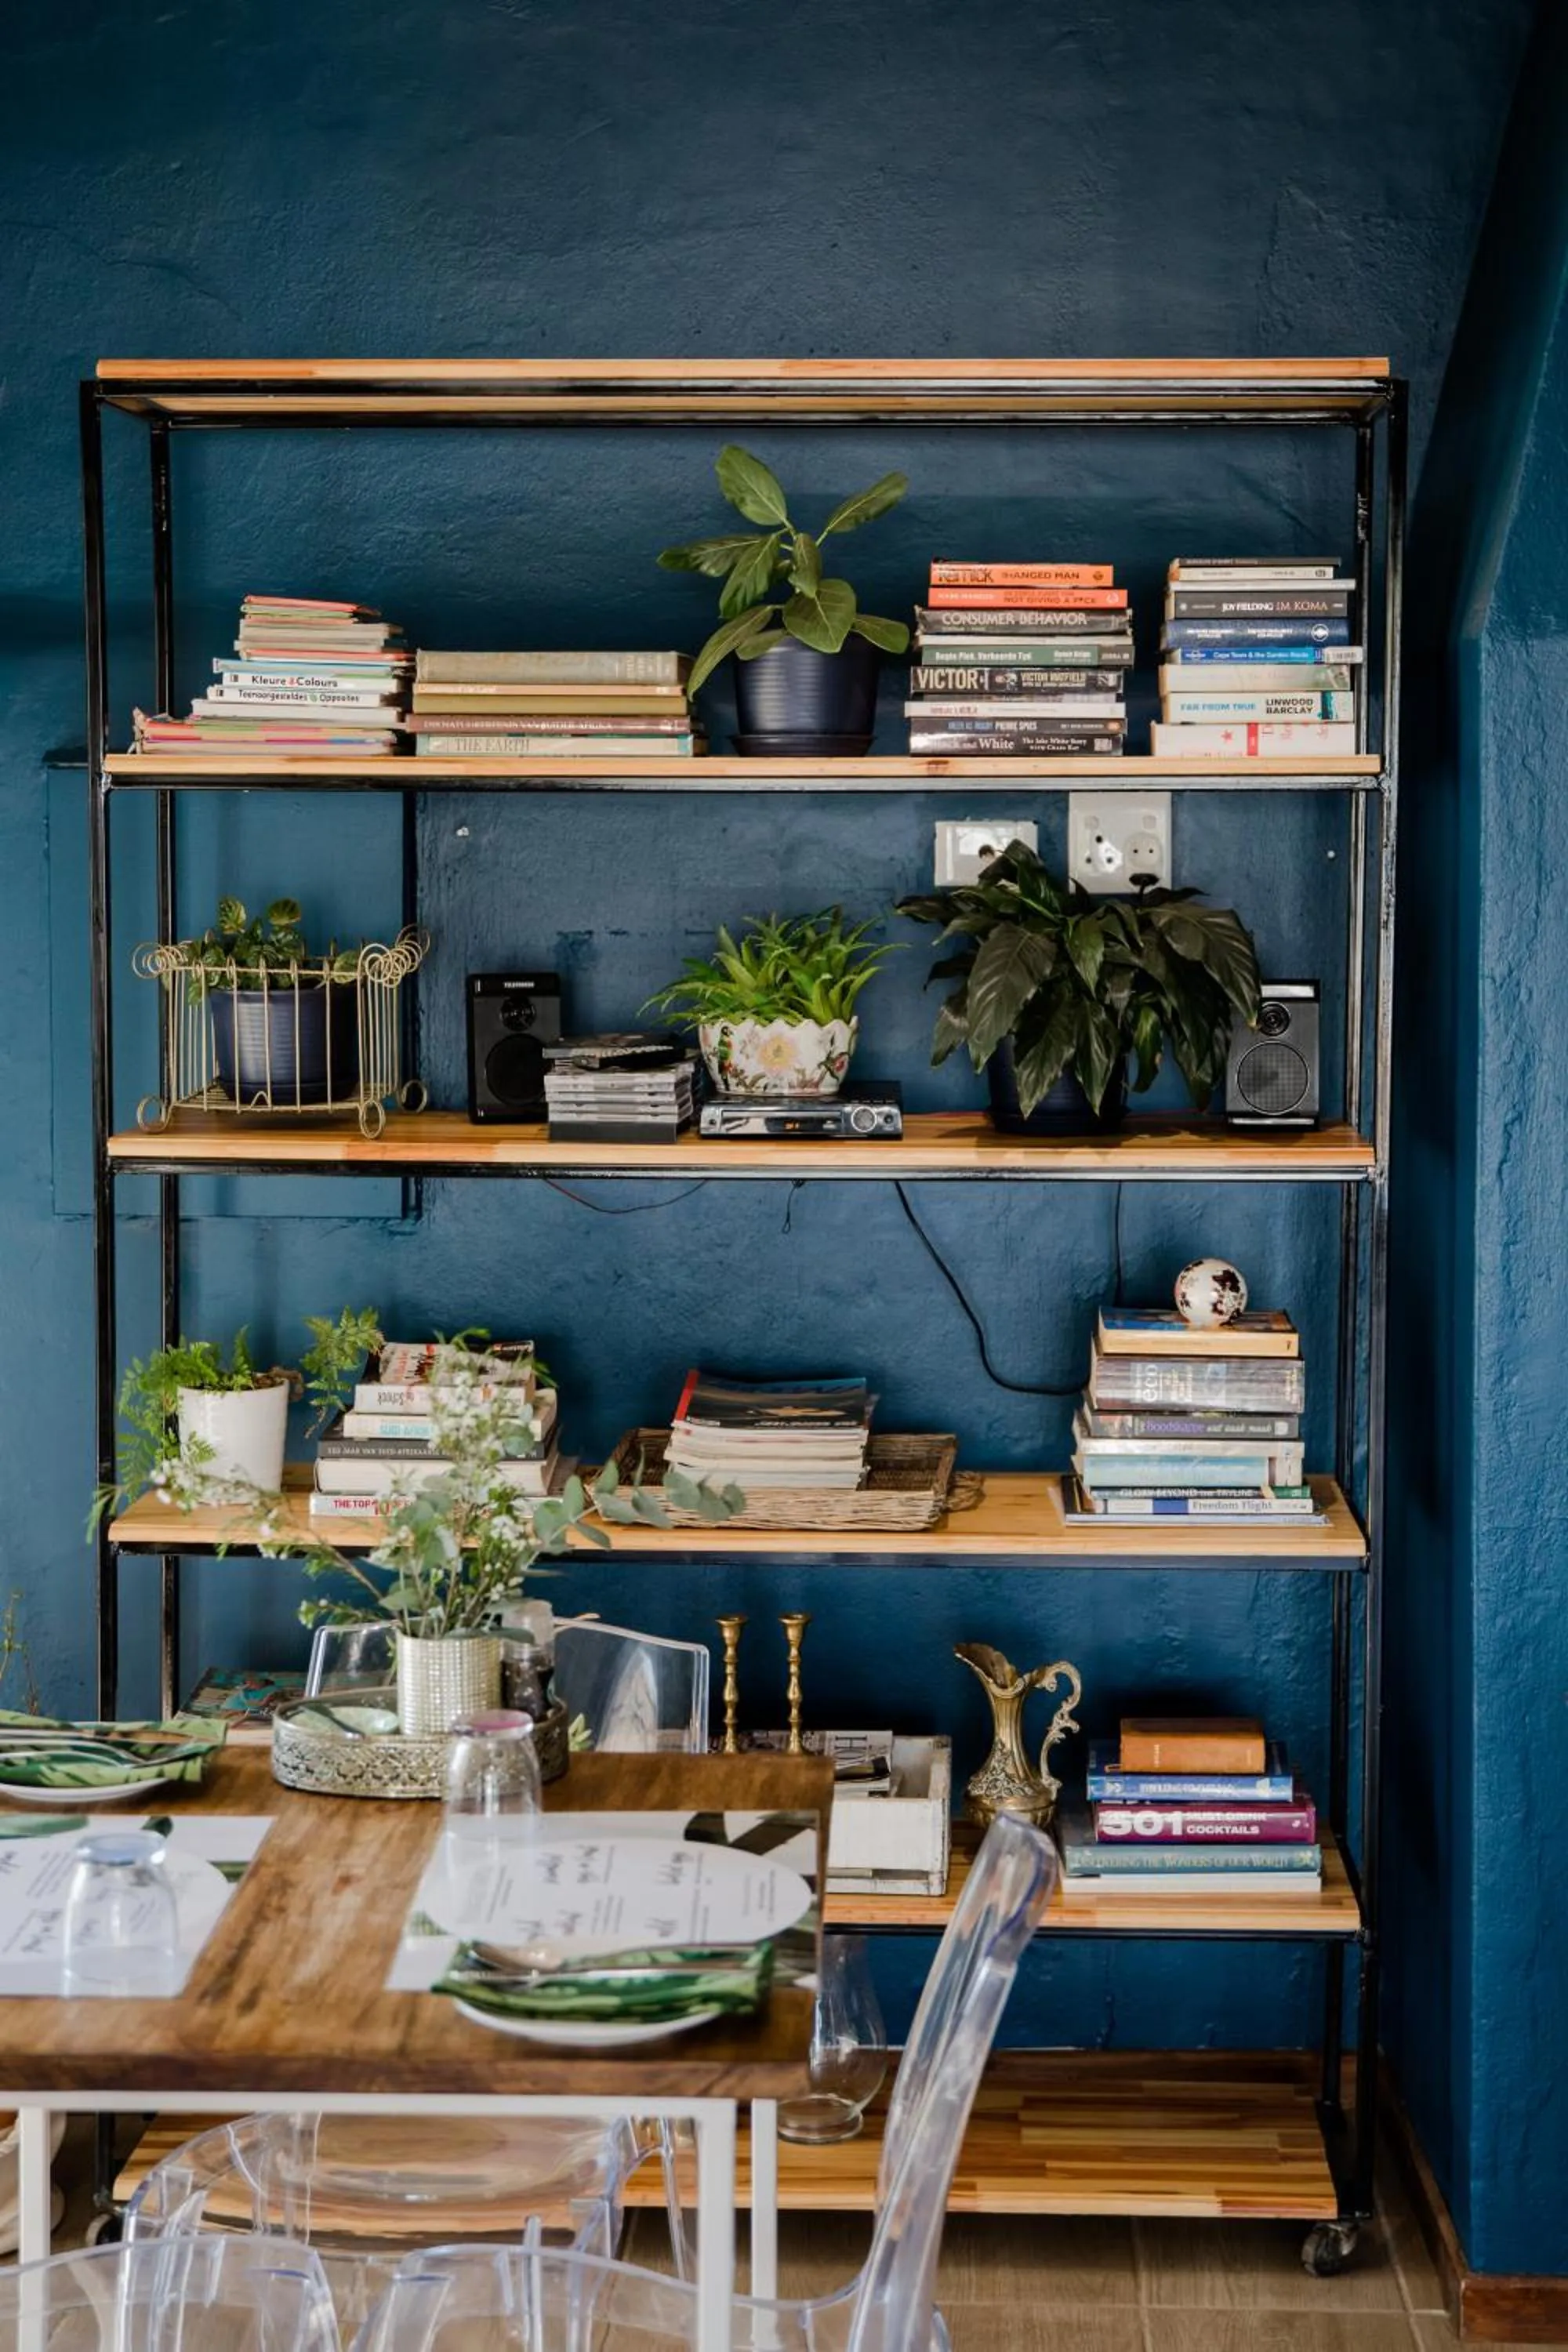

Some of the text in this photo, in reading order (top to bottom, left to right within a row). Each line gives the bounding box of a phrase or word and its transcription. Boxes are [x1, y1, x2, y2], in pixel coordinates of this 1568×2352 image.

[1294, 602, 1328, 611] KOMA
[942, 612, 1087, 626] CONSUMER BEHAVIOR
[252, 675, 286, 684] Kleure
[297, 677, 338, 688] Colours
[917, 668, 978, 689] VICTOR
[456, 739, 530, 752] THE EARTH
[978, 738, 1015, 750] White
[333, 1500, 350, 1509] THE
[352, 1500, 371, 1509] TOP
[1192, 1499, 1272, 1512] Freedom Flight
[1099, 1810, 1183, 1836] 501
[1186, 1824, 1260, 1835] COCKTAILS
